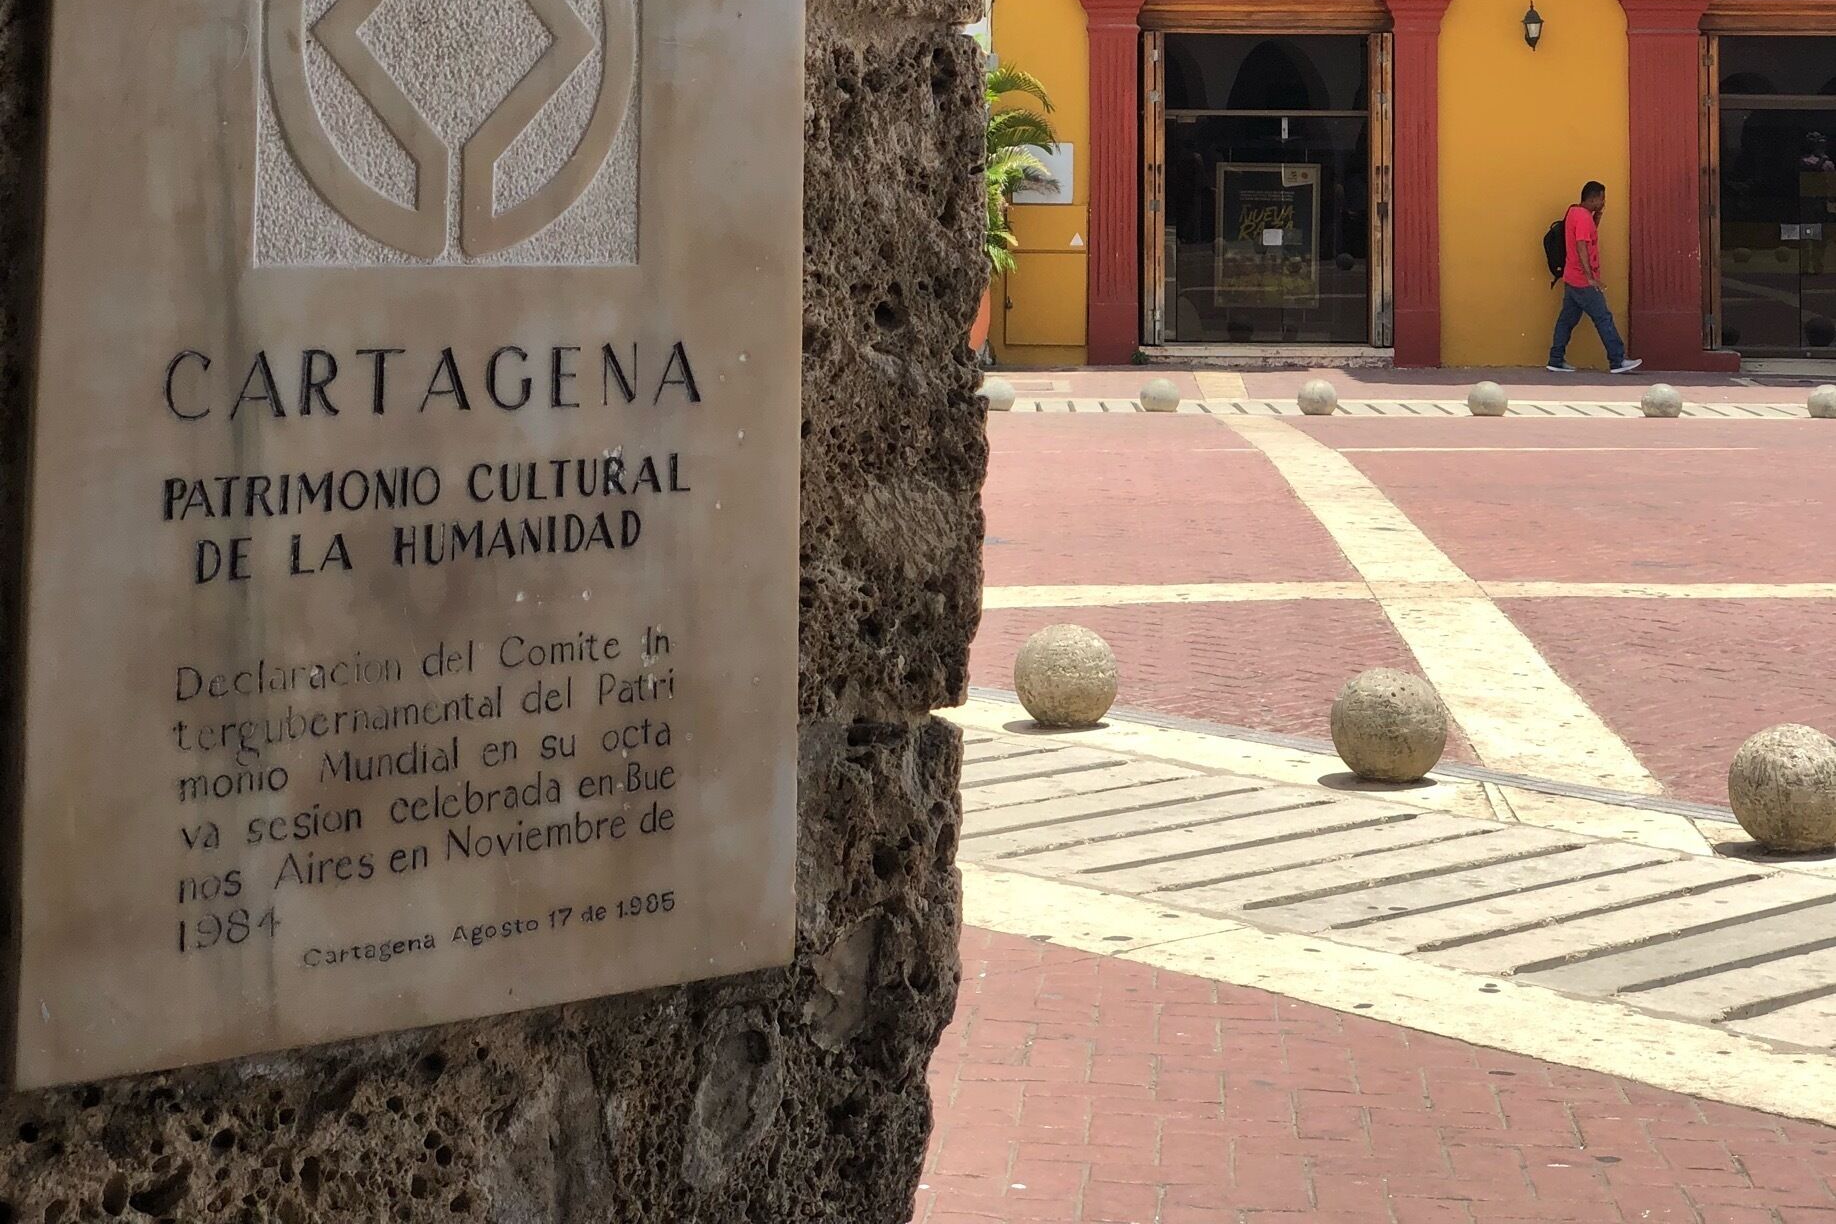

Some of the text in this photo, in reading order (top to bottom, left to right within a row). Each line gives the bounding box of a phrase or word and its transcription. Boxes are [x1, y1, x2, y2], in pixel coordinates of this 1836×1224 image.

[1239, 204, 1294, 223] NUEVA
[165, 341, 701, 421] CARTAGENA
[163, 453, 691, 521] PATRIMONIO CULTURAL
[196, 510, 642, 584] DE LA HUMANIDAD
[176, 626, 670, 701] Declaracion del Comite In
[174, 668, 674, 767] tergubernamental del Patri
[179, 718, 671, 802] monio Mundial en su octa
[181, 762, 676, 850] va sesion celebrada en Bue
[179, 801, 675, 904] nos Aires en Noviembre de
[179, 906, 280, 953] 1984
[303, 934, 436, 967] Cartagena
[451, 919, 539, 946] Agosto
[549, 907, 573, 929] 17
[581, 905, 607, 923] de
